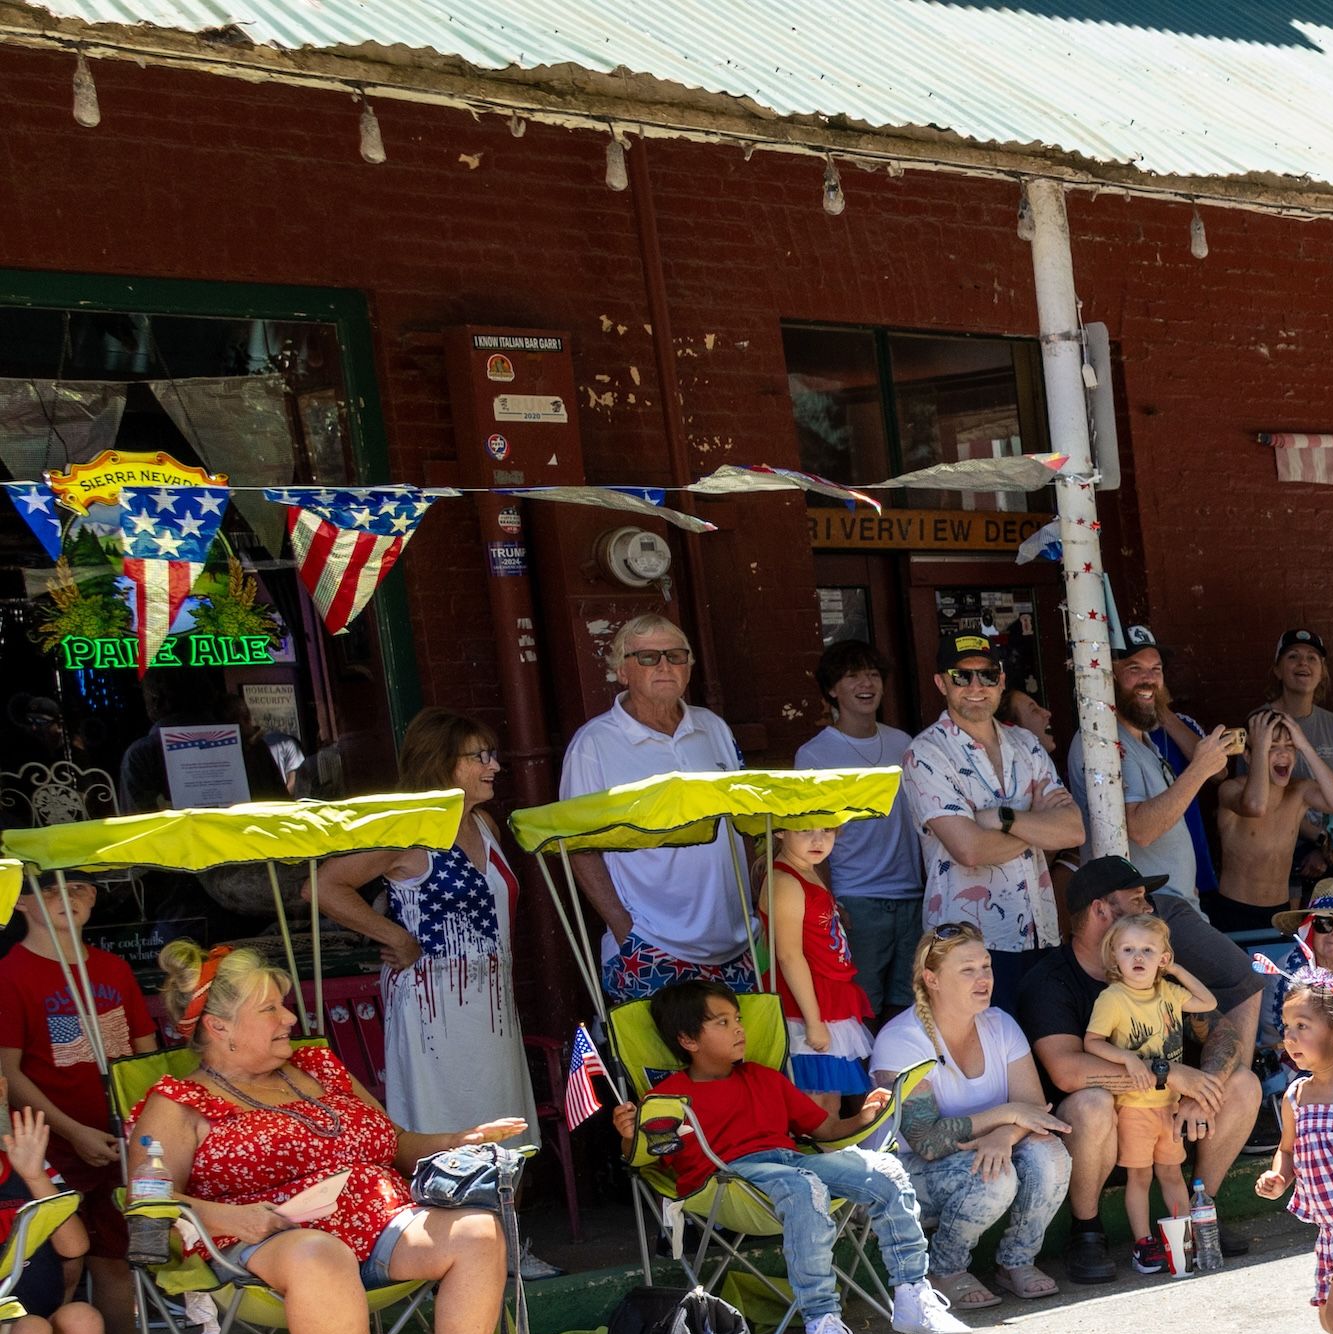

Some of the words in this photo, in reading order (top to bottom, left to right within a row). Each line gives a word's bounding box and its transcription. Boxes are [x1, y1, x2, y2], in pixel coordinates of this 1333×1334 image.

[478, 336, 498, 347] KNOW
[499, 337, 524, 348] ITALIAN
[524, 338, 538, 349] BAR
[80, 471, 136, 492] SIERRA
[807, 517, 972, 542] RIVERVIEW
[984, 518, 1043, 543] DEC
[62, 634, 182, 669] PALE
[190, 635, 275, 665] ALE
[245, 686, 293, 694] HOMELAND
[248, 695, 290, 704] SECURITY
[100, 936, 114, 952] for
[118, 931, 164, 948] cocktails
